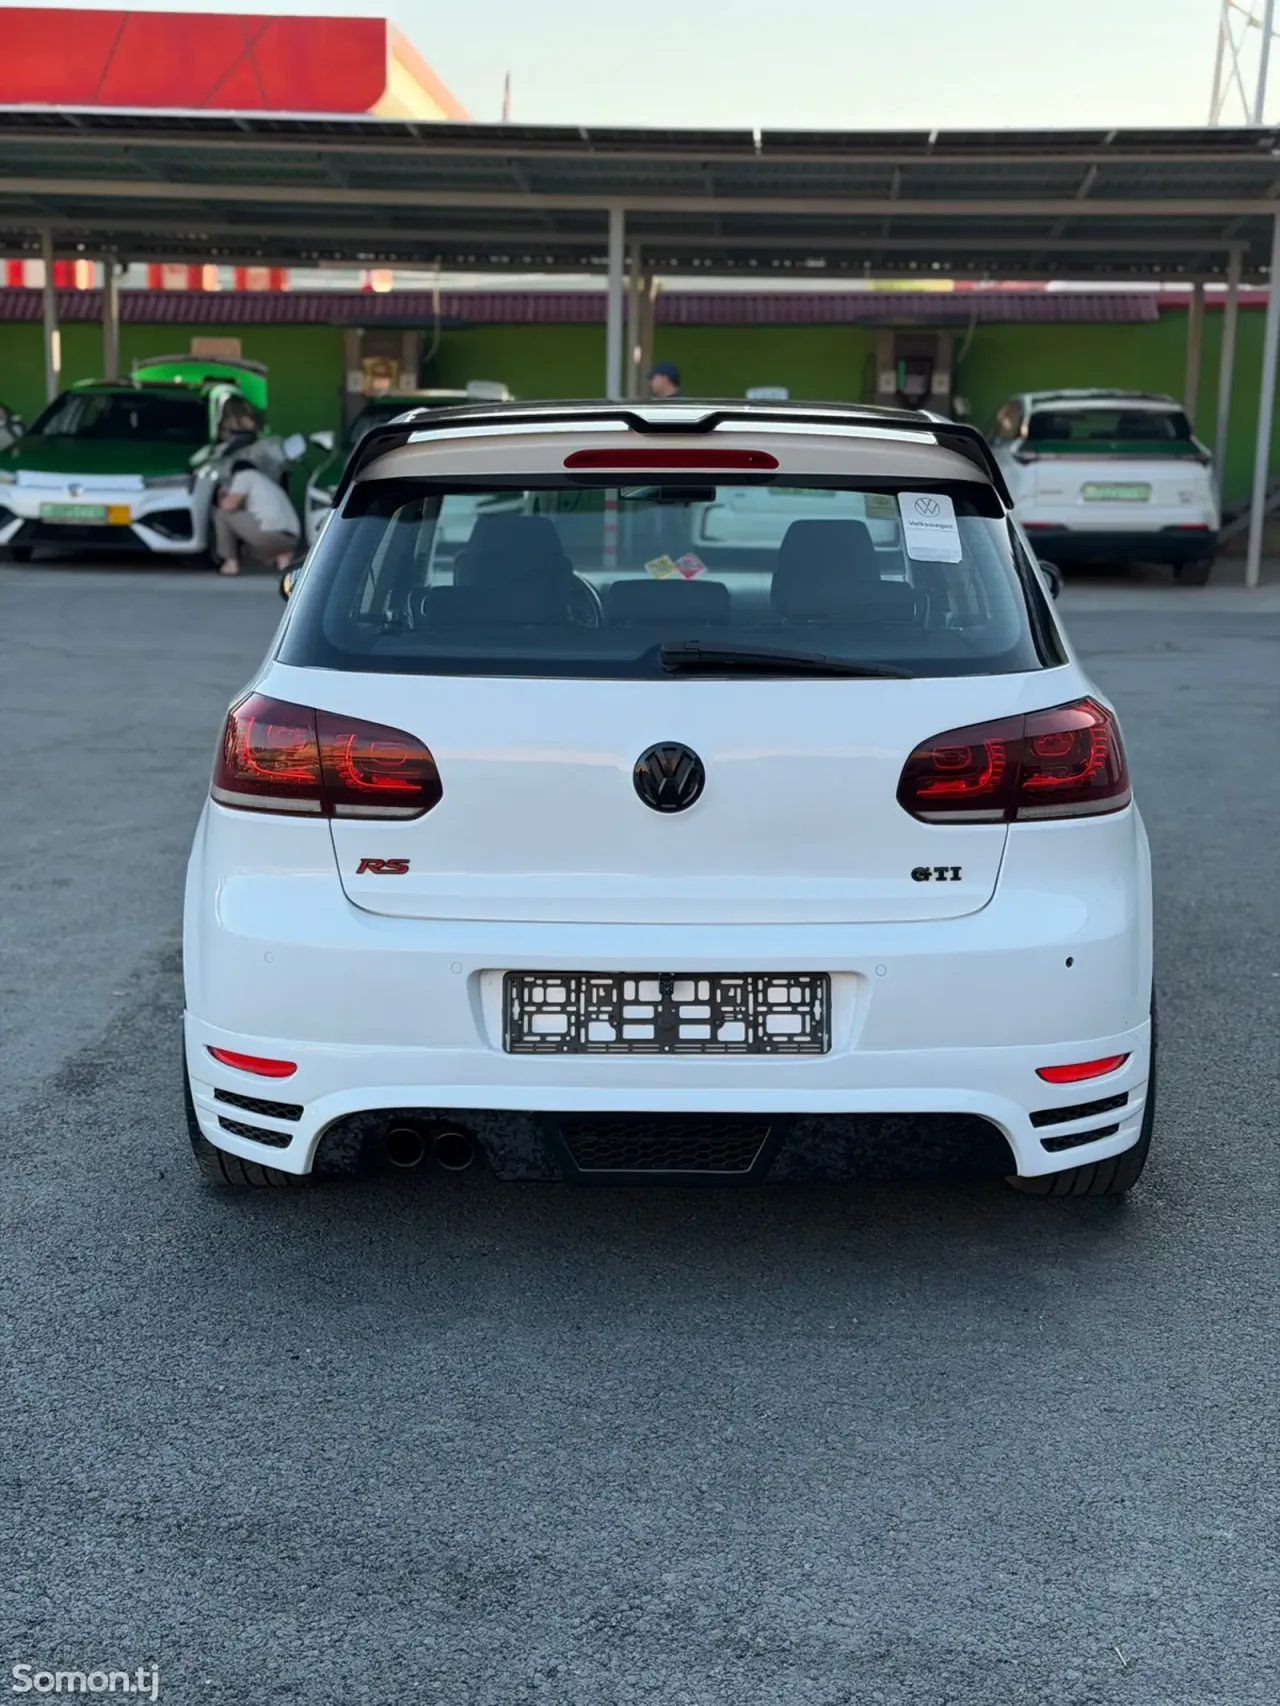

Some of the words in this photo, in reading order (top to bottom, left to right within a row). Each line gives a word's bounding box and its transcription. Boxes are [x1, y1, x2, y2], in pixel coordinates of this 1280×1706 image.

[908, 520, 953, 529] Volkswagen
[356, 858, 410, 875] RS
[911, 866, 962, 882] GTI
